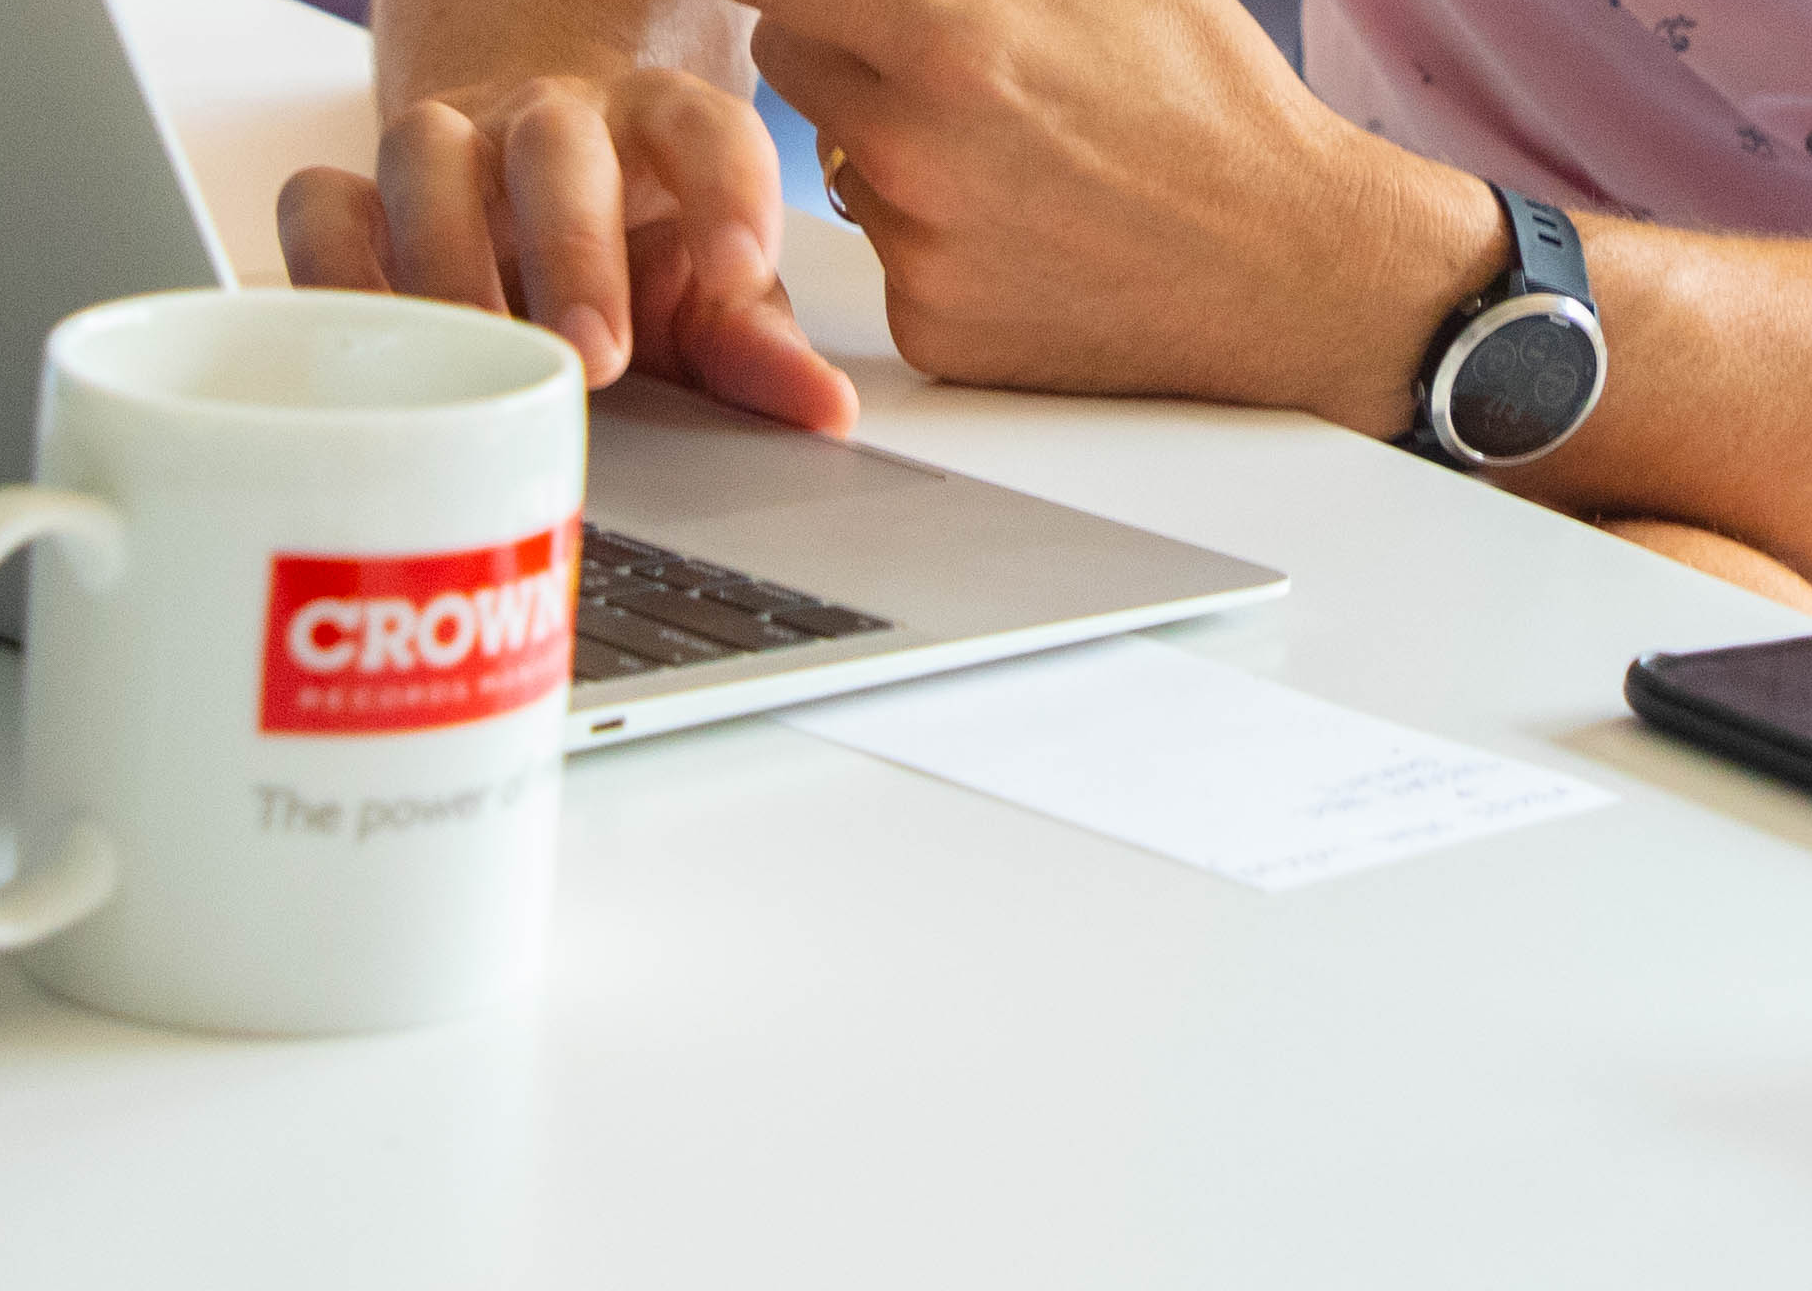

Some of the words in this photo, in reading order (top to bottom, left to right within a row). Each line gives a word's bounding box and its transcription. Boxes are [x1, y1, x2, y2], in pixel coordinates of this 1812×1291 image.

[288, 565, 567, 673] CROWN
[253, 783, 343, 835] The
[355, 783, 490, 843] power
